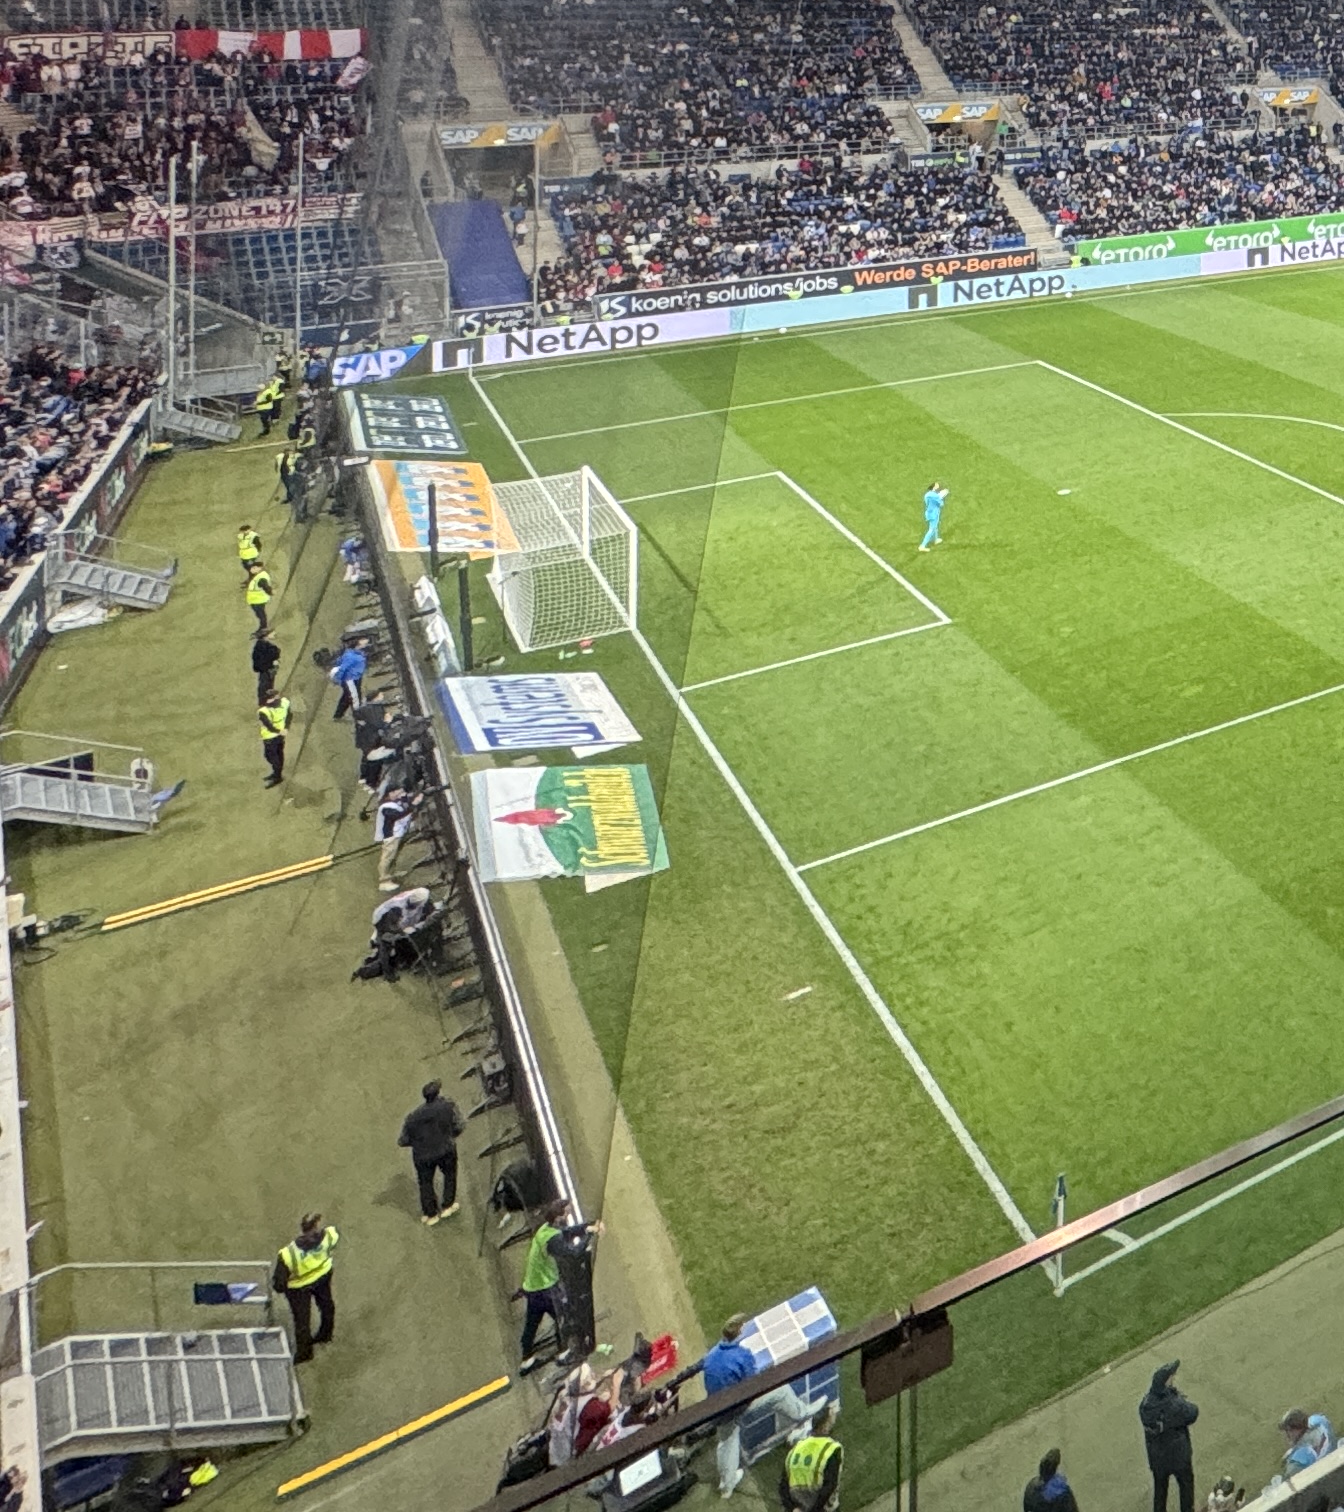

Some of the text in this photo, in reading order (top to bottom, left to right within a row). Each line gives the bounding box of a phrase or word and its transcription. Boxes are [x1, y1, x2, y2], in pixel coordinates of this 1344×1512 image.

[916, 106, 988, 120] SAP SAP
[441, 129, 479, 145] SAP
[855, 267, 916, 286] Werde
[922, 251, 1035, 279] SAP-Berater!
[953, 274, 1065, 303] NetApp
[505, 322, 660, 359] NetApp
[332, 349, 407, 386] SAP
